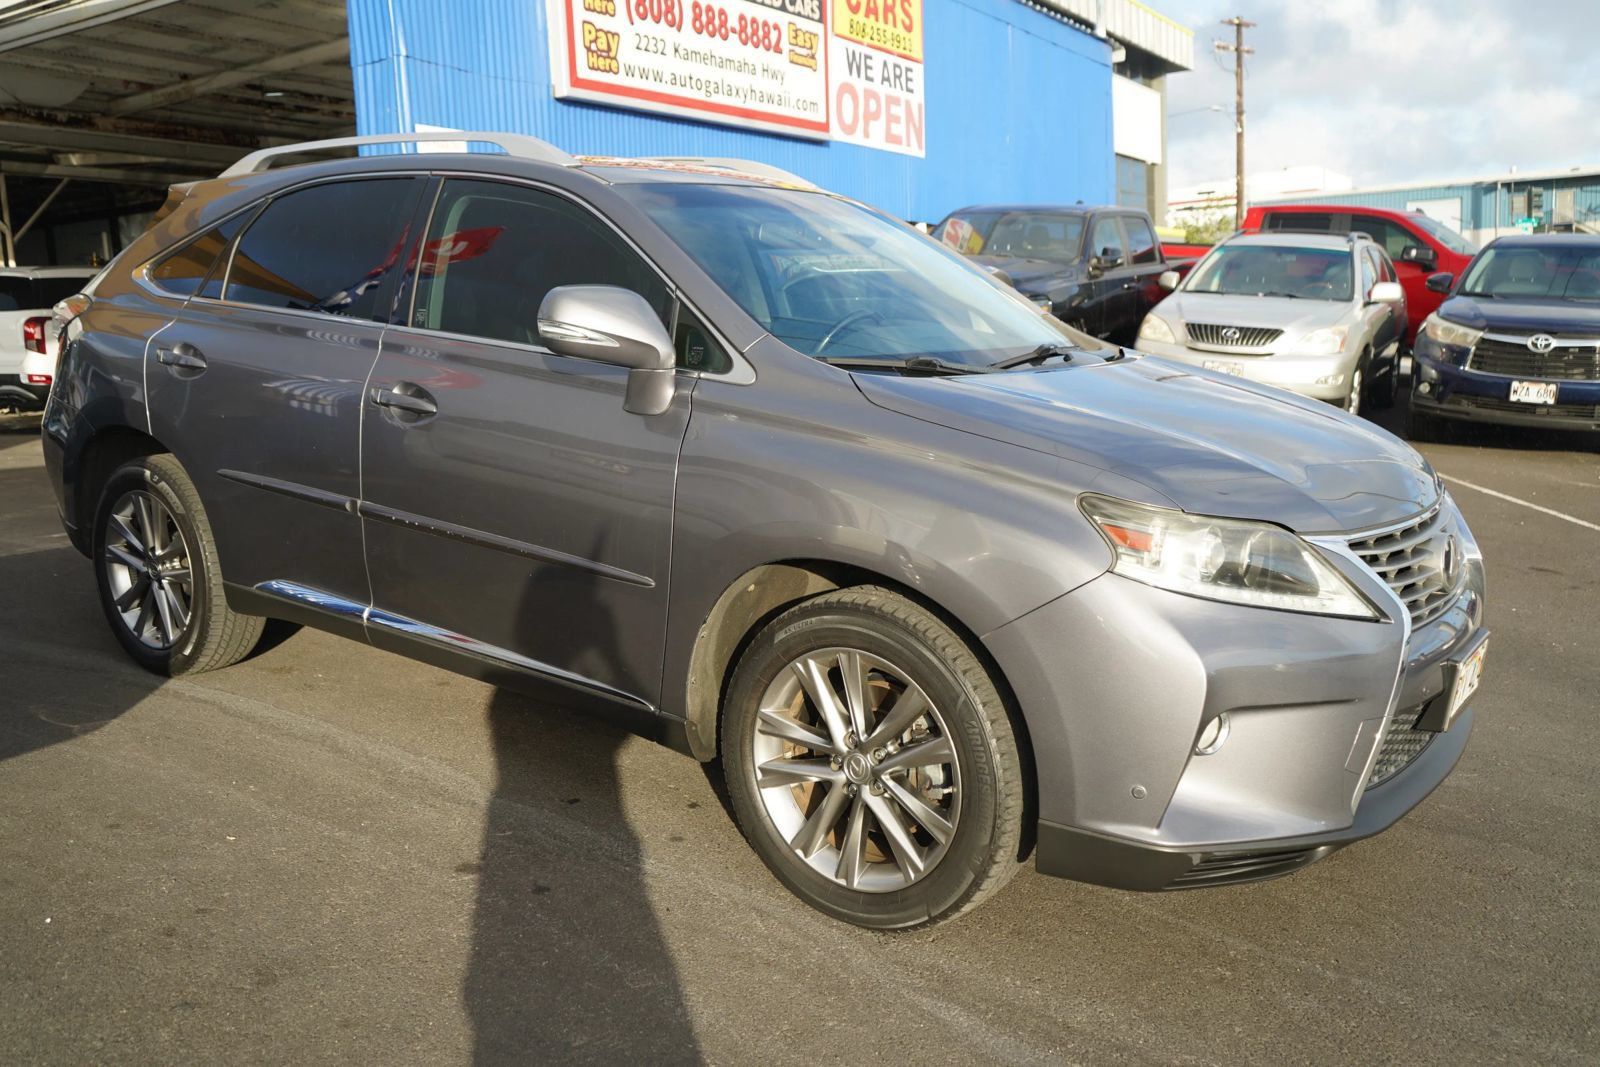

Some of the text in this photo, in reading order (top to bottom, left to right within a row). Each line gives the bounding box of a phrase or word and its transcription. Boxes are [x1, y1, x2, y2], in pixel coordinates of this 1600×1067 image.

[582, 20, 620, 59] Pay
[691, 1, 783, 54] 888-8882
[788, 21, 819, 56] Easy
[587, 50, 620, 75] Here
[635, 33, 785, 86] 2232 Kamehamaha Hwy
[845, 47, 874, 82] WE
[881, 60, 915, 94] ARE
[623, 63, 819, 113] www.autogalaxyhawaii.com
[836, 82, 923, 152] OPEN
